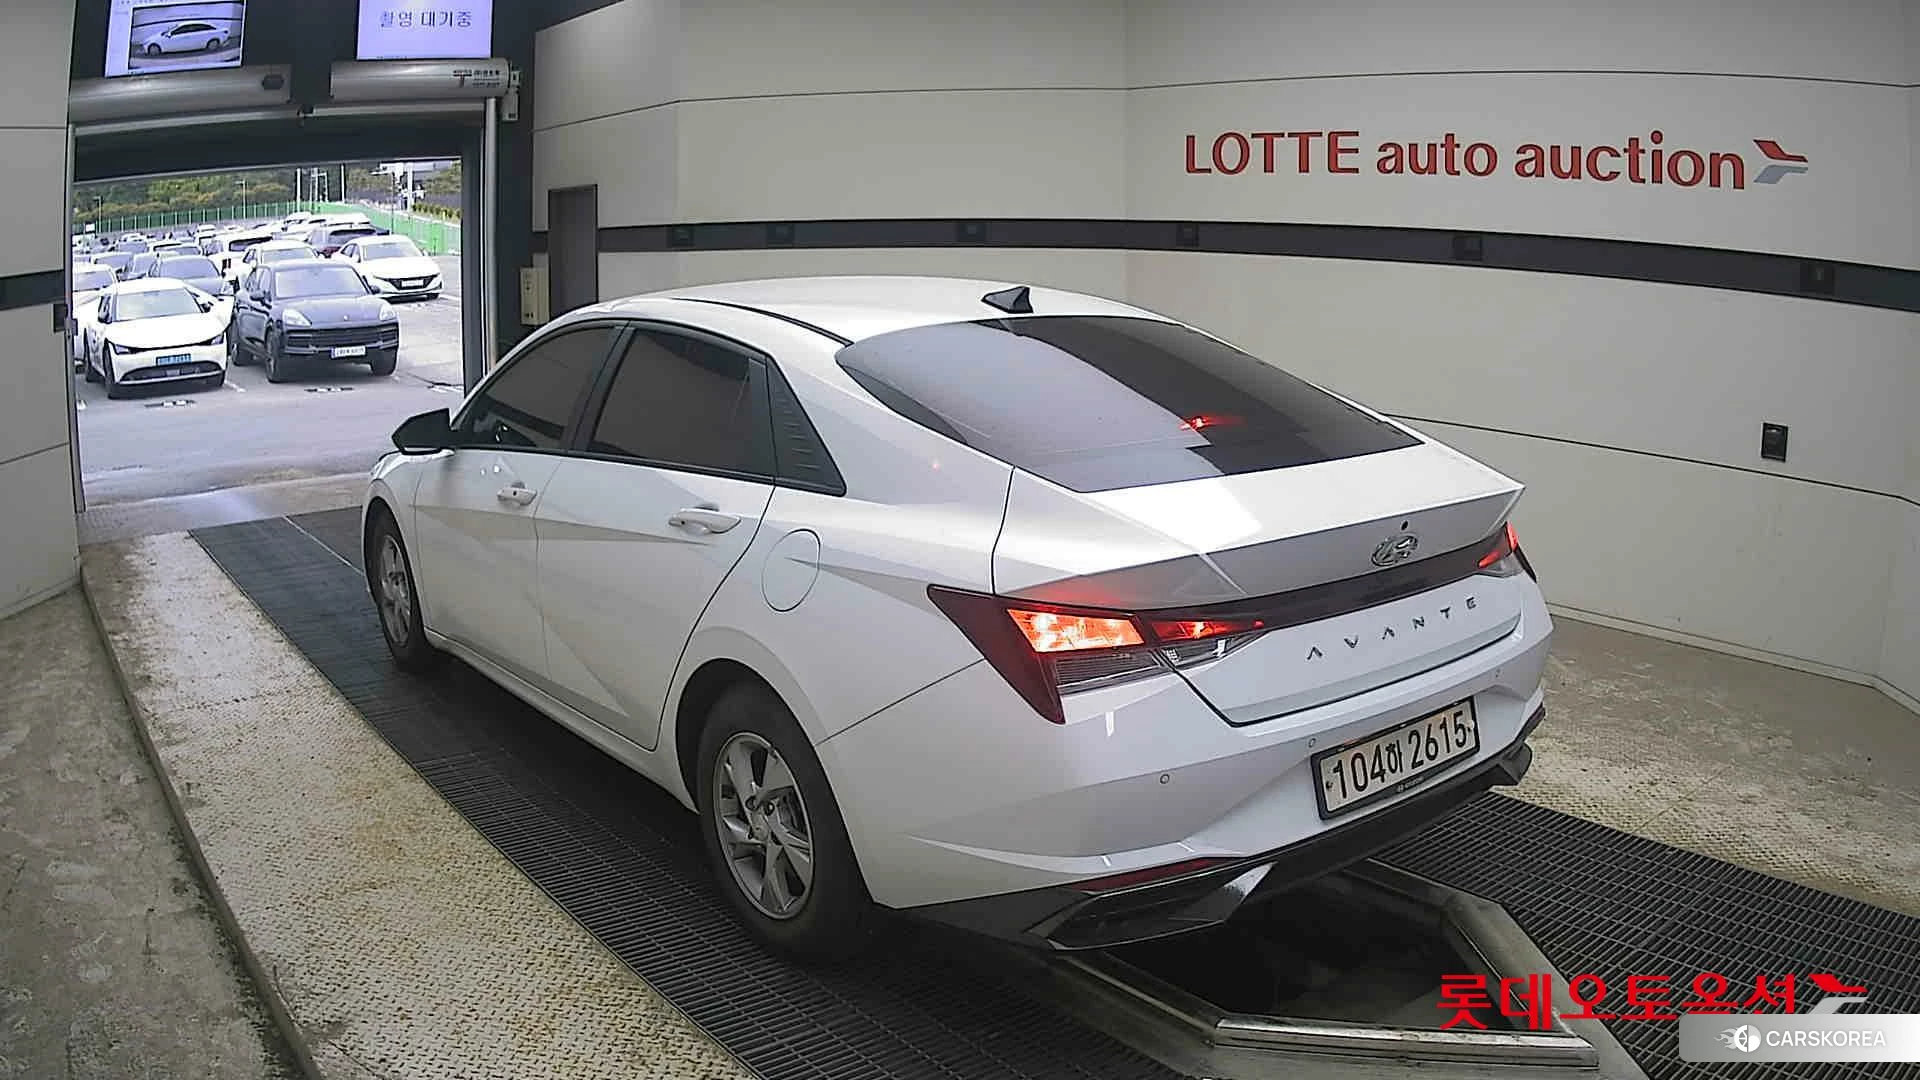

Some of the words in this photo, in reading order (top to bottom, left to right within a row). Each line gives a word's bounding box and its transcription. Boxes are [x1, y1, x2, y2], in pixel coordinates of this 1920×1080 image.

[421, 10, 472, 28] 대기중
[1185, 131, 1360, 175] LOTTE
[1376, 133, 1498, 177] auto
[1514, 130, 1745, 190] auction
[1306, 596, 1477, 661] AVANTE
[1408, 710, 1467, 770] 2615
